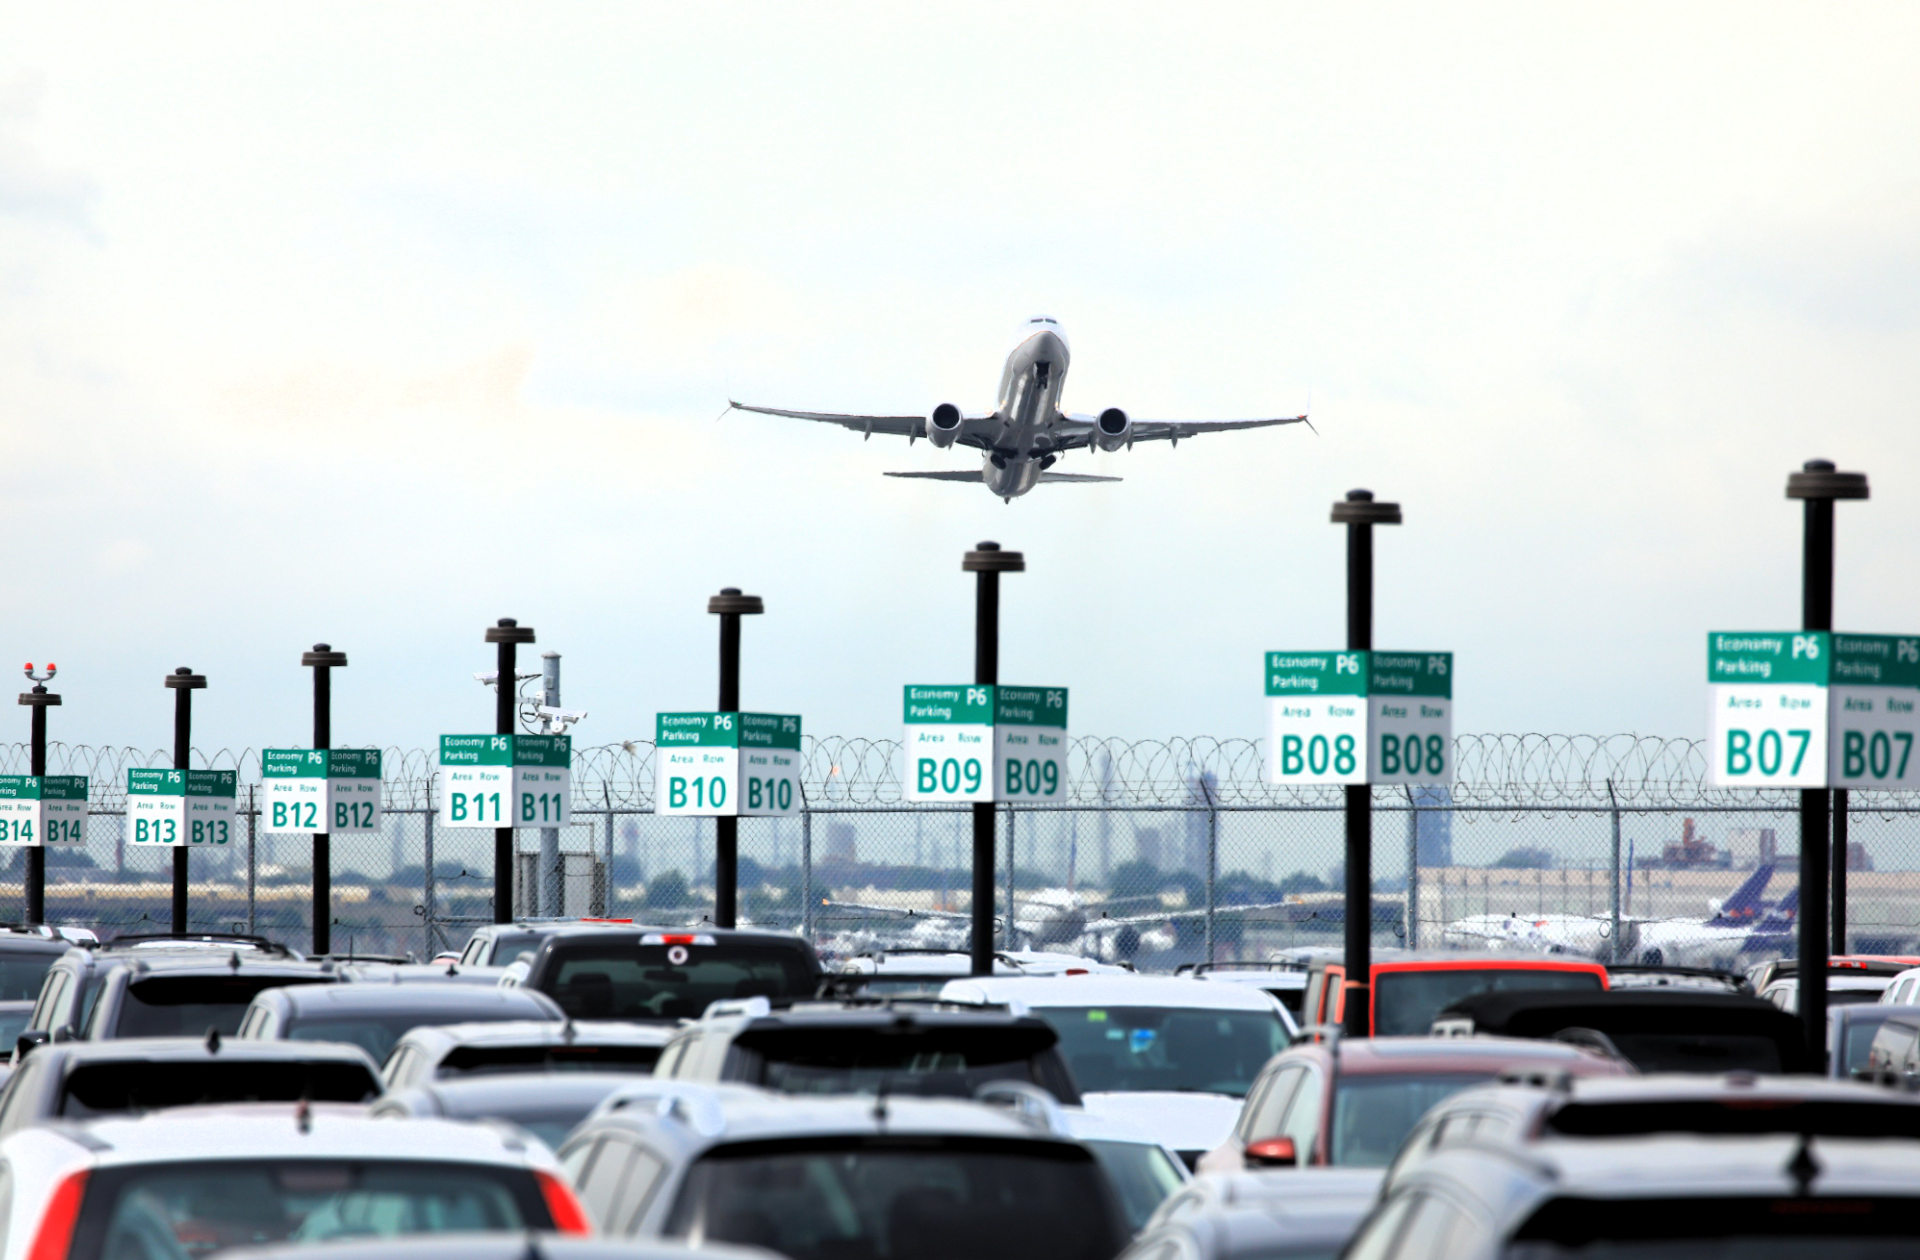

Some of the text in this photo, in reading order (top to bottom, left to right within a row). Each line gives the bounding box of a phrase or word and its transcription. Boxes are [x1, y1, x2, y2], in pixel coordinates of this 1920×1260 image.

[1716, 636, 1820, 659] Economy P6
[1836, 638, 1919, 663] Economy P6
[1272, 655, 1359, 674] Economy P6
[1374, 655, 1447, 675] Economy P6
[1716, 659, 1772, 678] Parking
[1836, 661, 1881, 679] Parking
[1272, 676, 1319, 691] Parking
[1374, 675, 1413, 691] Parking
[910, 688, 987, 706] Economy P6
[1000, 690, 1063, 708] Economy P6
[1728, 696, 1811, 709] Area Row
[1282, 706, 1355, 717] Area Row
[1382, 705, 1444, 718] Area Row
[1845, 698, 1914, 712] Area Row
[910, 706, 952, 720] Parking
[1000, 707, 1033, 721] Parking
[662, 716, 732, 730] Economy P6
[744, 716, 797, 733] Economy P6
[662, 731, 700, 743] Parking
[744, 731, 772, 743] Parking
[919, 733, 982, 743] Area Row
[1007, 733, 1060, 745] Area Row
[445, 738, 507, 751] Economy P6
[517, 738, 567, 751] Economy P6
[268, 752, 322, 764] Economy P6
[331, 750, 378, 765] Economy P6
[445, 750, 478, 762] Parking
[517, 750, 544, 762] Parking
[670, 754, 725, 763] Area Row
[1282, 734, 1356, 775] B08
[1382, 734, 1444, 775] B08
[1727, 728, 1812, 777] B07
[1844, 730, 1914, 779] B07
[750, 756, 791, 766] Area Row
[267, 764, 297, 775] Parking
[331, 764, 356, 775] Parking
[918, 758, 982, 794] B09
[26, 778, 37, 788] P6
[44, 777, 85, 788] Economy P6
[132, 770, 181, 783] Economy P6
[188, 772, 233, 784] Economy P6
[452, 772, 500, 781] Area Row
[522, 772, 561, 781] Area Row
[1006, 758, 1059, 796] B09
[44, 787, 66, 797] Parking
[132, 782, 158, 792] Parking
[188, 784, 212, 793] Parking
[274, 784, 317, 793] Area Row
[336, 784, 373, 793] Area Row
[670, 776, 726, 808] B10
[749, 778, 792, 810] B10
[18, 804, 32, 812] Row
[48, 804, 80, 812] Area Row
[137, 802, 176, 810] Area Row
[193, 803, 208, 811] Area
[452, 793, 500, 821] B11
[522, 794, 561, 822] B11
[272, 802, 318, 828] B12
[335, 802, 374, 828] B12
[48, 820, 81, 842] B14
[136, 819, 176, 843] B13
[192, 821, 229, 844] B13
